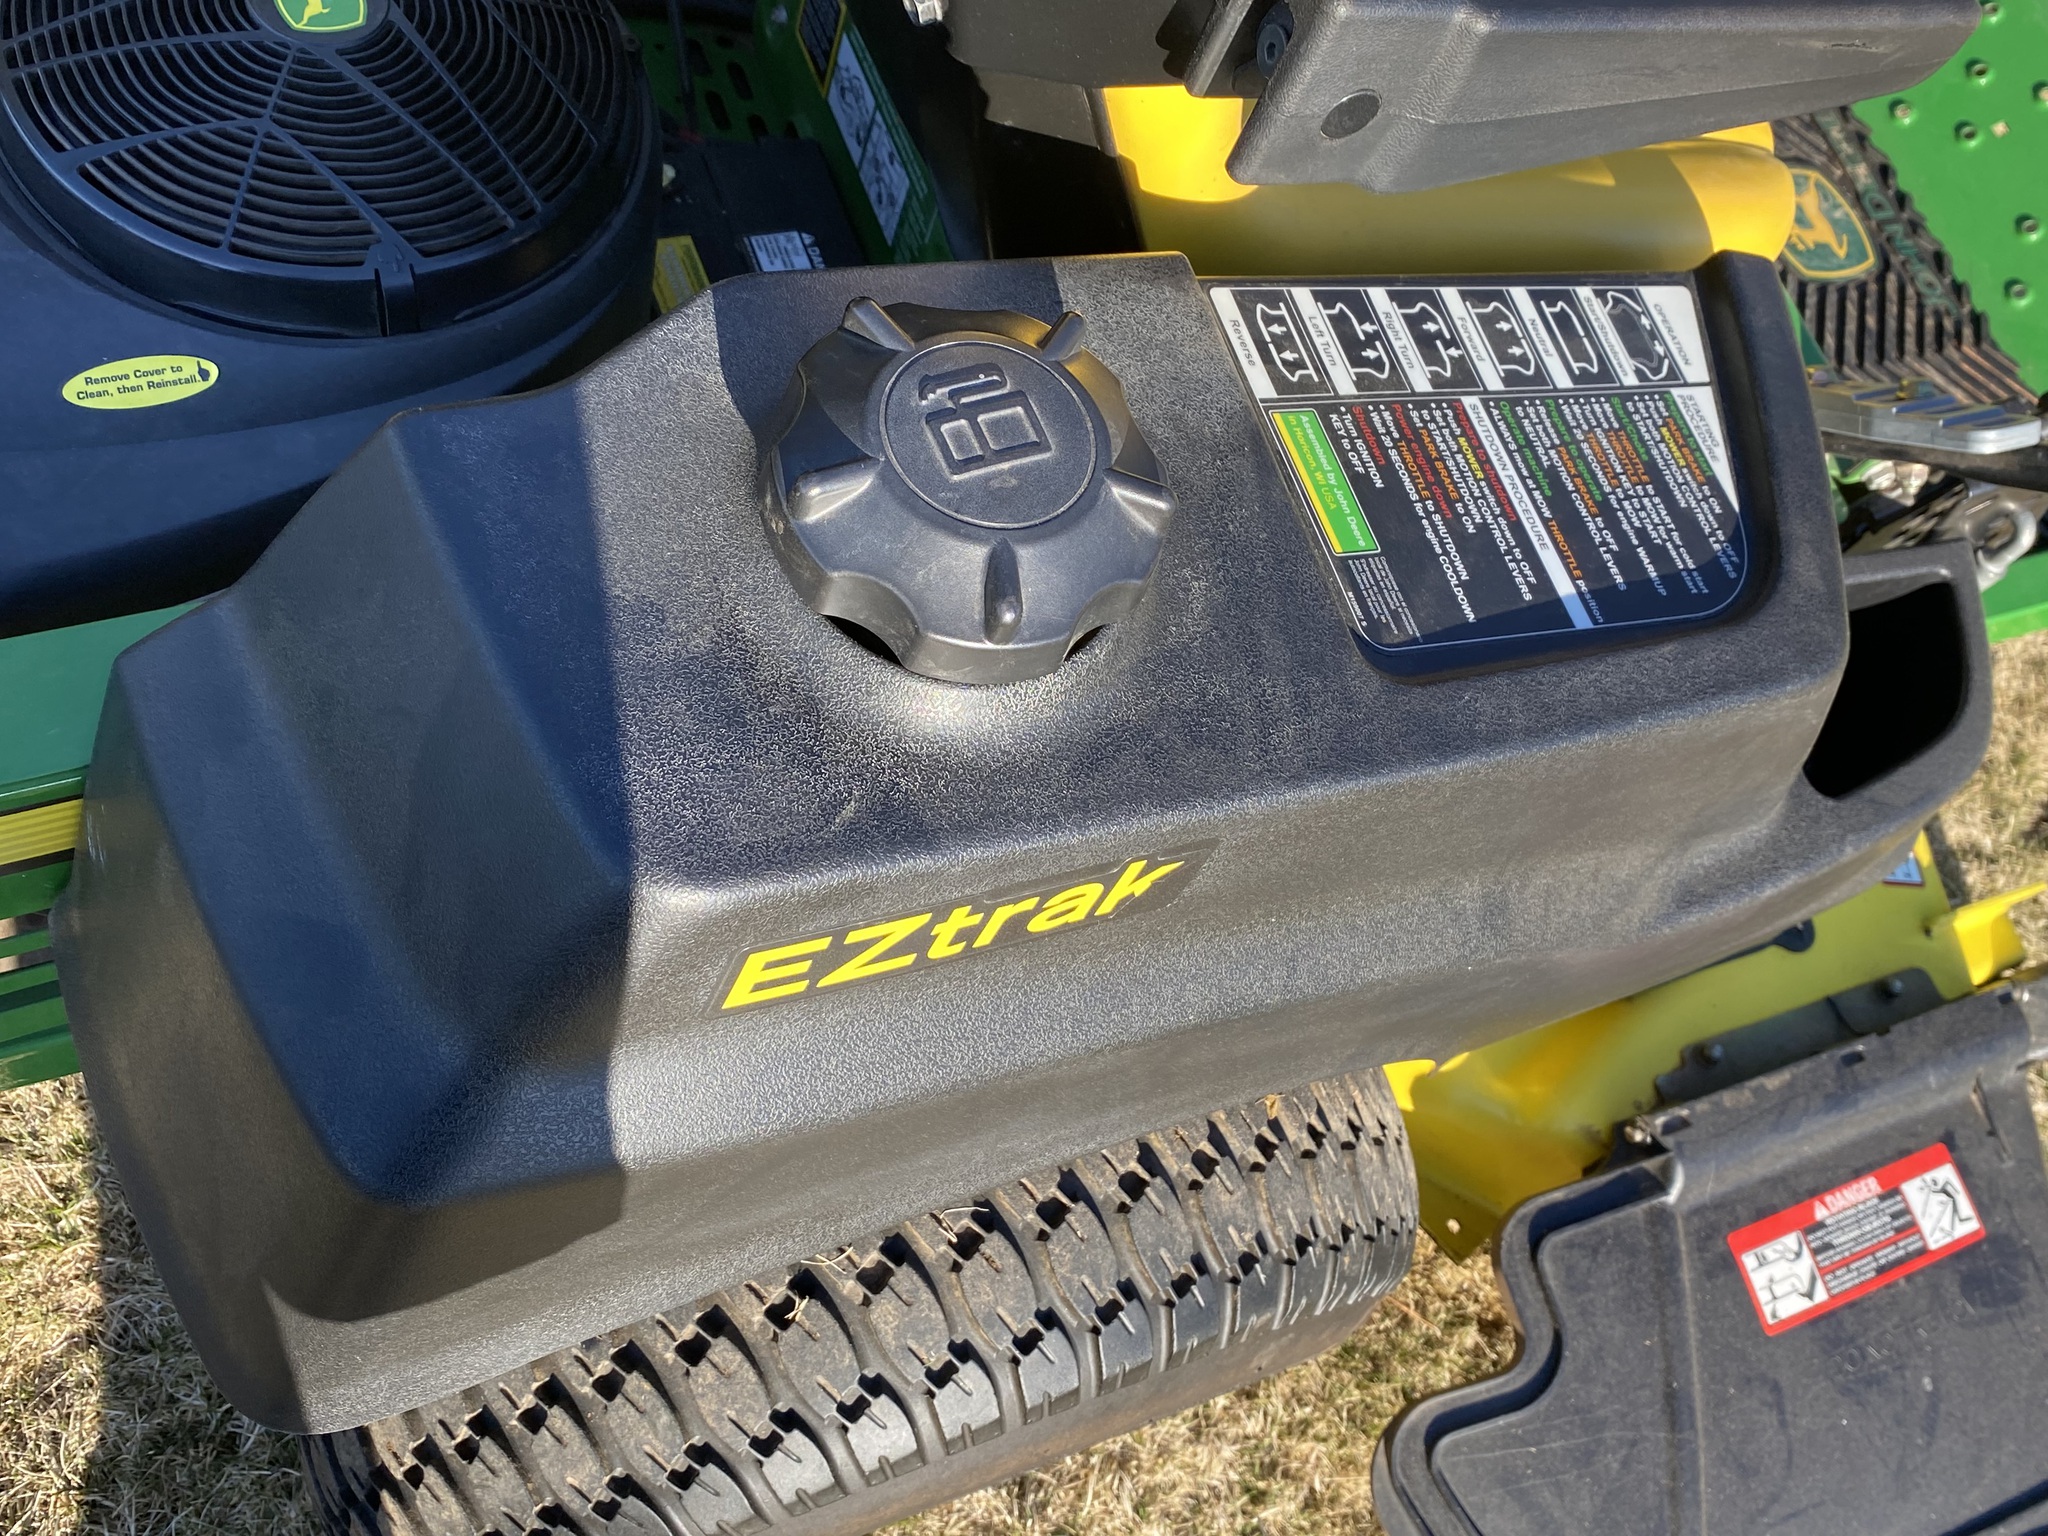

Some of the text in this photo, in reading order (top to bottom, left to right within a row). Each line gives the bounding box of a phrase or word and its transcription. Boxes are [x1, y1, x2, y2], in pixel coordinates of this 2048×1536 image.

[76, 375, 201, 401] Clean, then Reinstall.
[84, 365, 183, 387] Remove Cover to
[1227, 319, 1259, 366] Reverse
[1306, 316, 1339, 366] Left Turn
[1378, 311, 1417, 368] Right Turn
[1455, 316, 1486, 362] Forward
[1526, 317, 1555, 357] Neutral
[1580, 296, 1632, 376] Start/Shutdown
[1651, 303, 1693, 365] OPERATION
[1286, 415, 1338, 509] in Horicon, WI USA
[1327, 413, 1365, 474] KEY to OFF
[1340, 412, 1385, 488] Turn IGNITION
[1350, 405, 1388, 465] Shutdown
[1390, 403, 1454, 518] Power engine down
[1408, 410, 1477, 533] Set PARK BRAKE to ON
[1419, 409, 1483, 523] to START/SHUTDOWN
[1449, 401, 1518, 521] Prepare to shutdown
[1496, 400, 1554, 496] Operate machine
[1514, 406, 1553, 469] to NEUTRAL
[1542, 398, 1604, 502] Prepare to operate
[1569, 404, 1642, 528] Move THROTTLE to MOW
[1580, 404, 1663, 545] Turn IGNITION KEY to START
[1608, 395, 1651, 461] Start/Choke
[1624, 401, 1688, 508] to START/SHUTDOWN
[1654, 399, 1723, 513] Set PARK BRAKE to ON
[1660, 393, 1713, 475] Prepare to start
[1676, 394, 1720, 462] PROCEDURE
[1684, 394, 1720, 447] STARTING
[1297, 414, 1333, 470] Assembled
[1322, 472, 1339, 485] by
[1331, 487, 1353, 514] John
[1345, 516, 1368, 547] Deere
[1368, 411, 1478, 623] Wait 20 SECONDS for engine COOLDOWN
[1380, 410, 1470, 580] Move THROTTLE to SHUTDOWN
[1430, 409, 1533, 601] Set both MOTION CONTROL LEVERS
[1442, 408, 1537, 584] Push MOWER switch down to OFF
[1467, 403, 1550, 550] SHUTDOWN PROCEDURE
[1488, 407, 1606, 623] ALWAYS mow at MOW THROTTLE position
[1524, 405, 1628, 591] Set both MOTION CONTROL LEVERS
[1535, 405, 1619, 552] Release PARK BRAKE to OFF
[1559, 404, 1668, 596] Wait 20 SECONDS for engine WARMUP
[1590, 402, 1699, 594] Move THROTTLE to MOW for warm start
[1600, 402, 1710, 593] Move THROTTLE to START for cold start
[1634, 400, 1738, 579] Set both MOTION CONTROL LEVERS
[1644, 400, 1739, 563] Push MOWER switch down to OFF
[721, 859, 1184, 1010] EZtrak
[1824, 1176, 1883, 1214] DANGER
